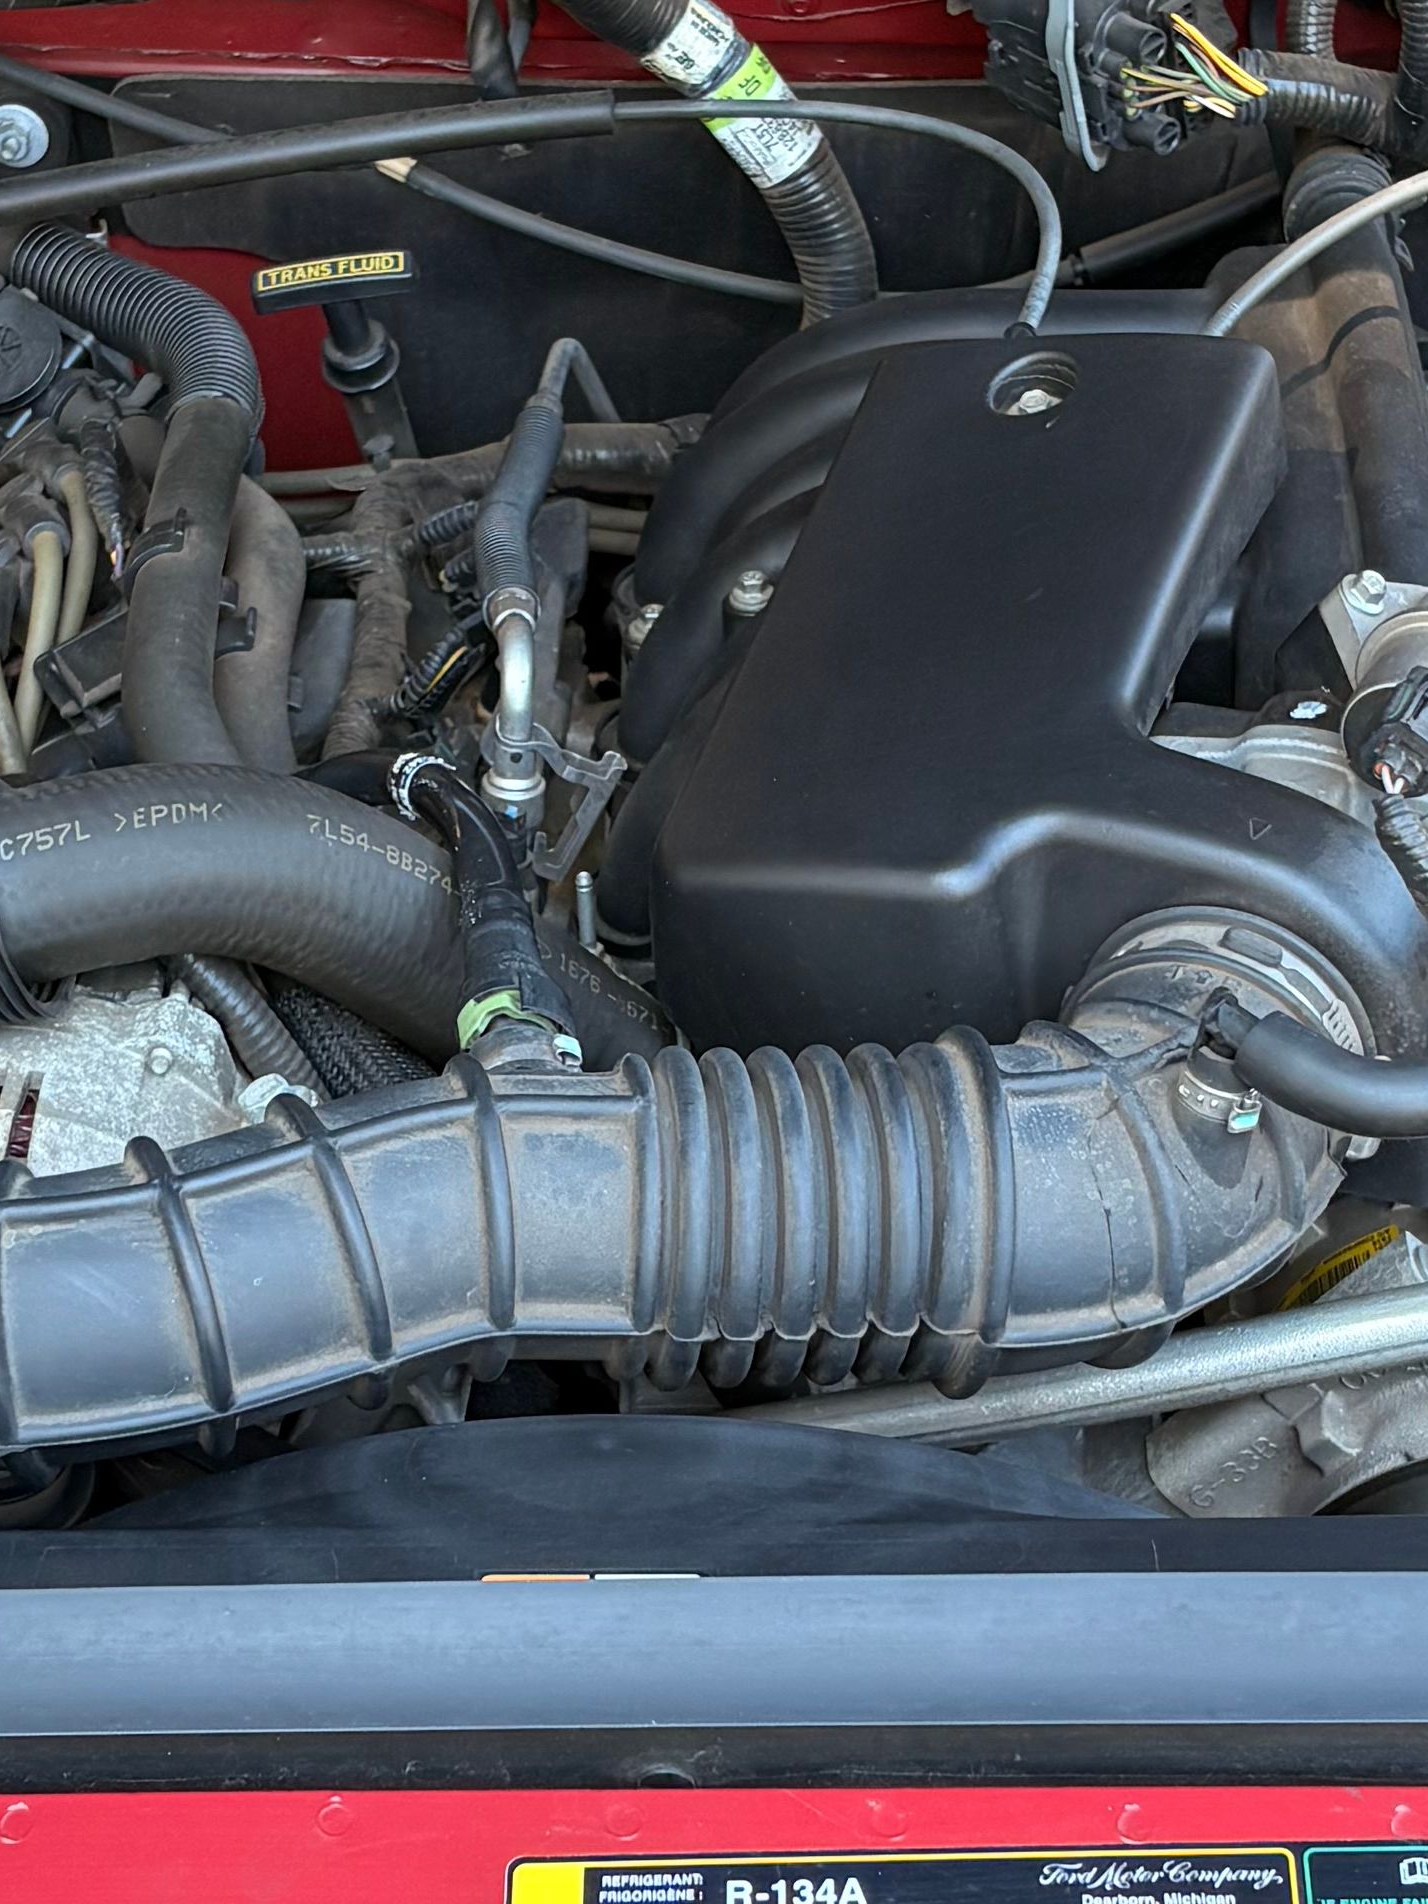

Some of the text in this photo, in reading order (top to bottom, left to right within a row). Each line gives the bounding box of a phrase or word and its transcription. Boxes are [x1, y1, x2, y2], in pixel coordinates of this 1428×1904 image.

[268, 257, 394, 284] TRANS FLUID
[0, 821, 91, 862] C757L
[602, 1873, 703, 1888] REFRIGERANT:
[1039, 1860, 1283, 1890] Ford Motor Company
